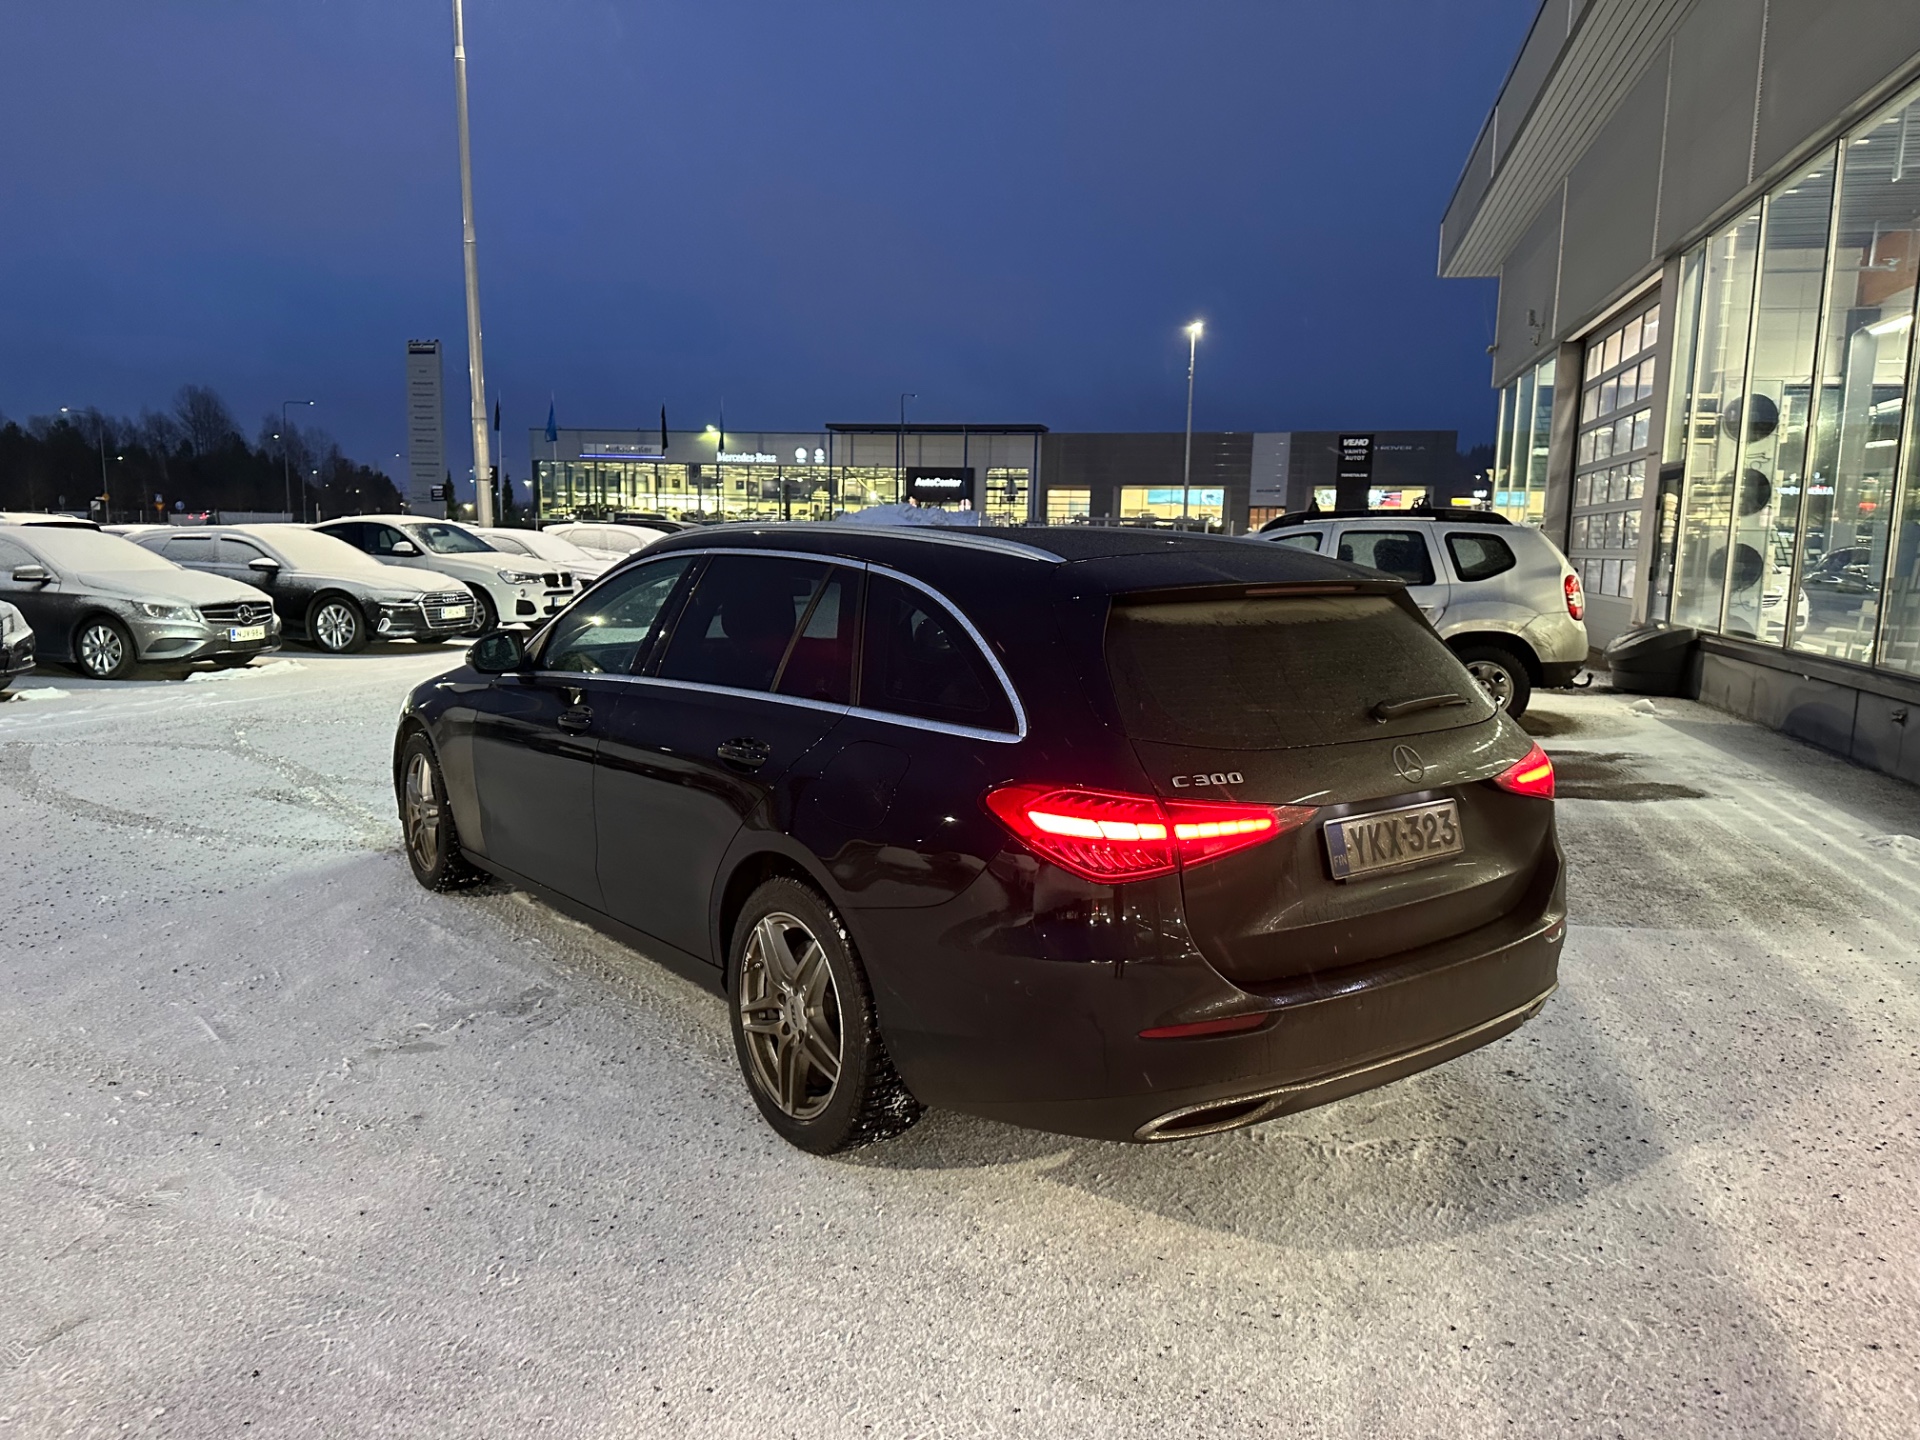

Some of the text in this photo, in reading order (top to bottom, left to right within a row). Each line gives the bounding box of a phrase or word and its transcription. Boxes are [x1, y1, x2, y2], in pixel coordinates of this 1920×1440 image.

[1343, 438, 1370, 446] VEHO
[716, 451, 777, 462] Mercedes-Benz
[914, 477, 963, 487] AutoCenter
[1171, 771, 1245, 788] C 300
[1349, 809, 1457, 864] YKX-323
